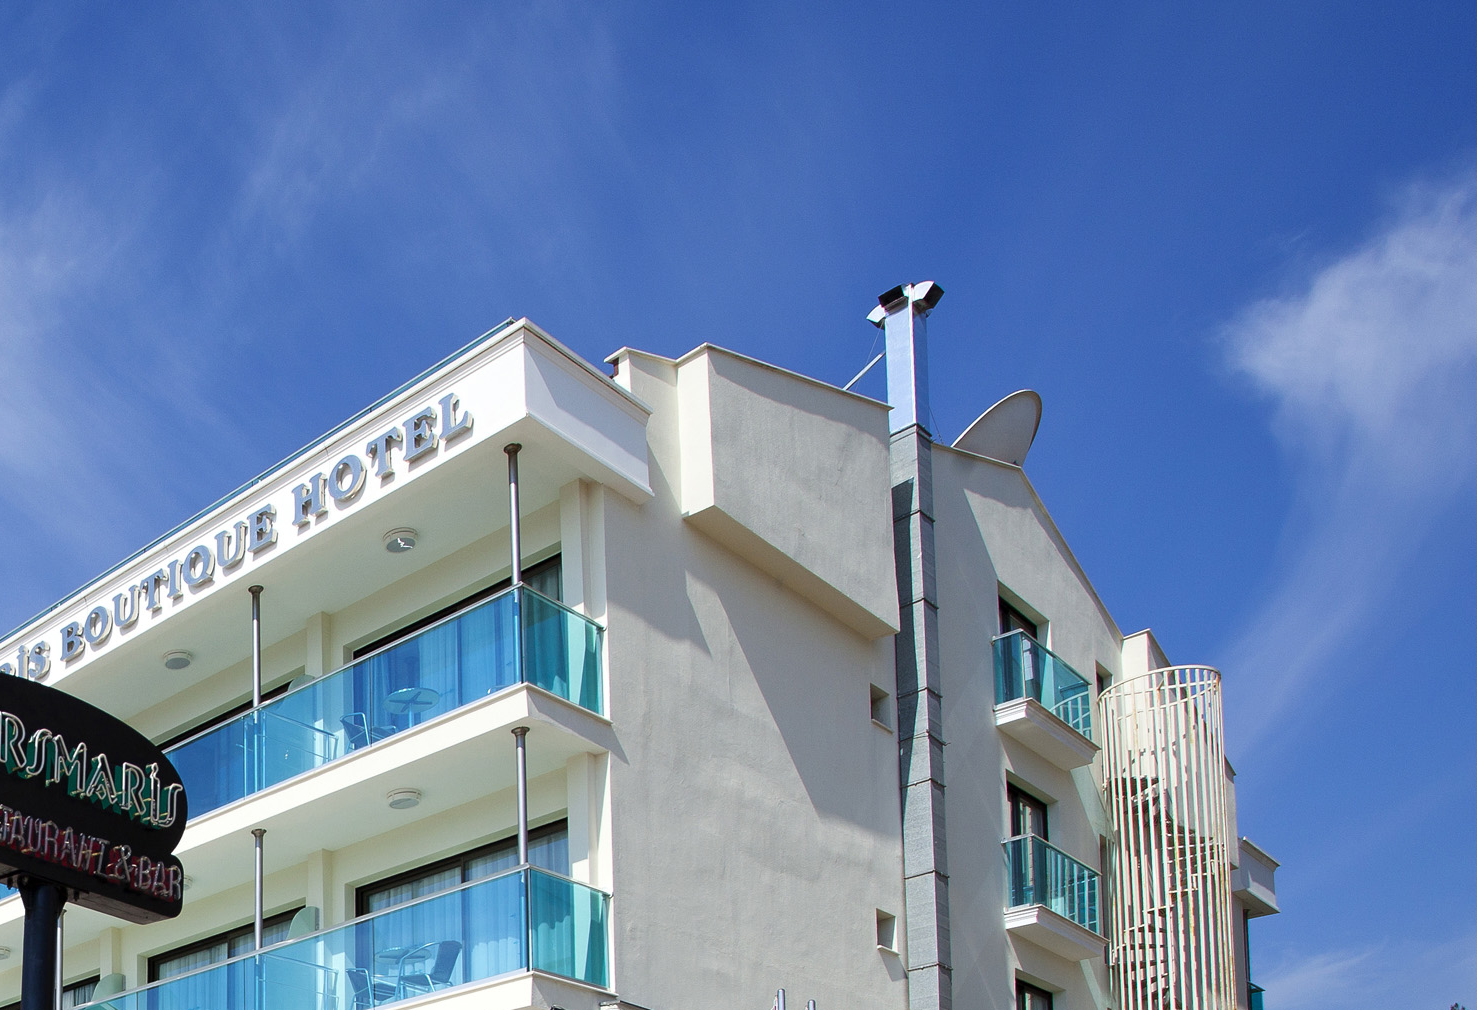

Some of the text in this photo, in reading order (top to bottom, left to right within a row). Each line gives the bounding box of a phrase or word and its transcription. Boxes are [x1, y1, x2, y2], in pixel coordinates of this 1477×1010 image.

[59, 502, 278, 663] BOUTIQUE
[291, 392, 475, 528] HOTEL
[131, 855, 182, 902] BAR
